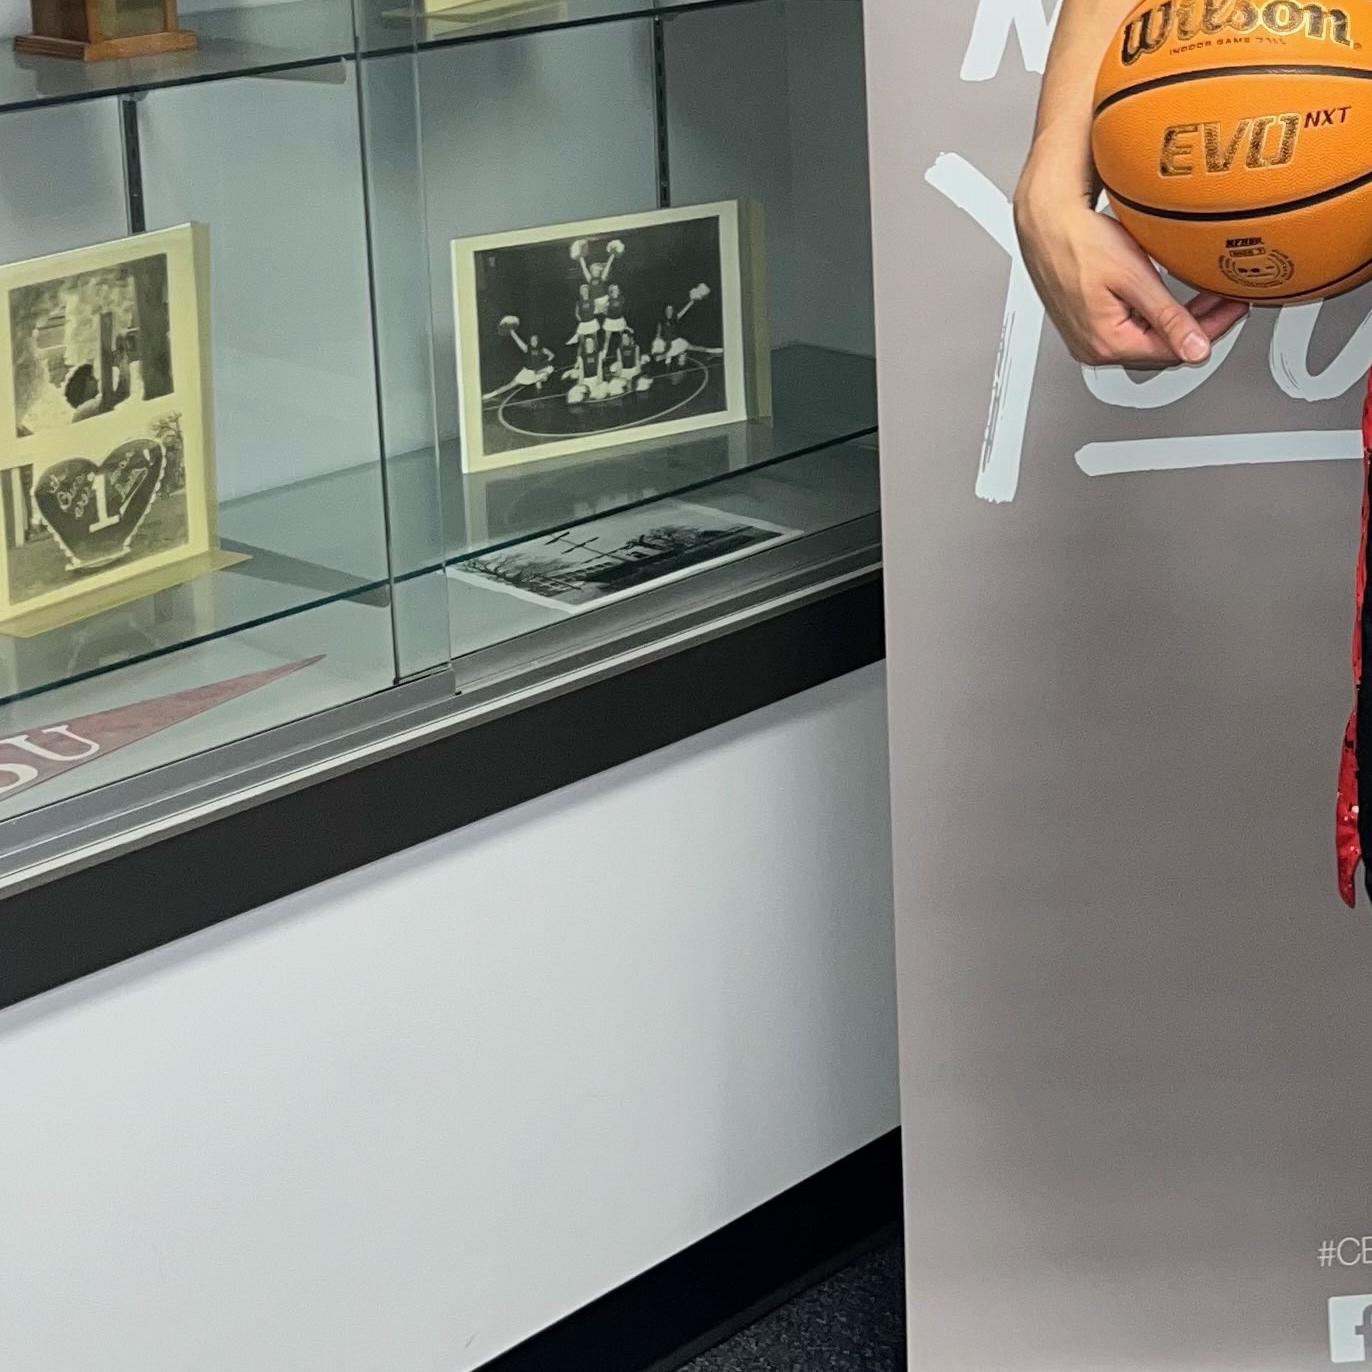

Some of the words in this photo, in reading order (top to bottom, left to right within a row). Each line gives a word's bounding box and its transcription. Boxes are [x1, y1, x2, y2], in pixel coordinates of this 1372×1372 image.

[1169, 39, 1213, 56] INDOOR
[1216, 36, 1251, 47] GAME
[1159, 112, 1302, 177] EVO
[1304, 106, 1353, 128] NXT
